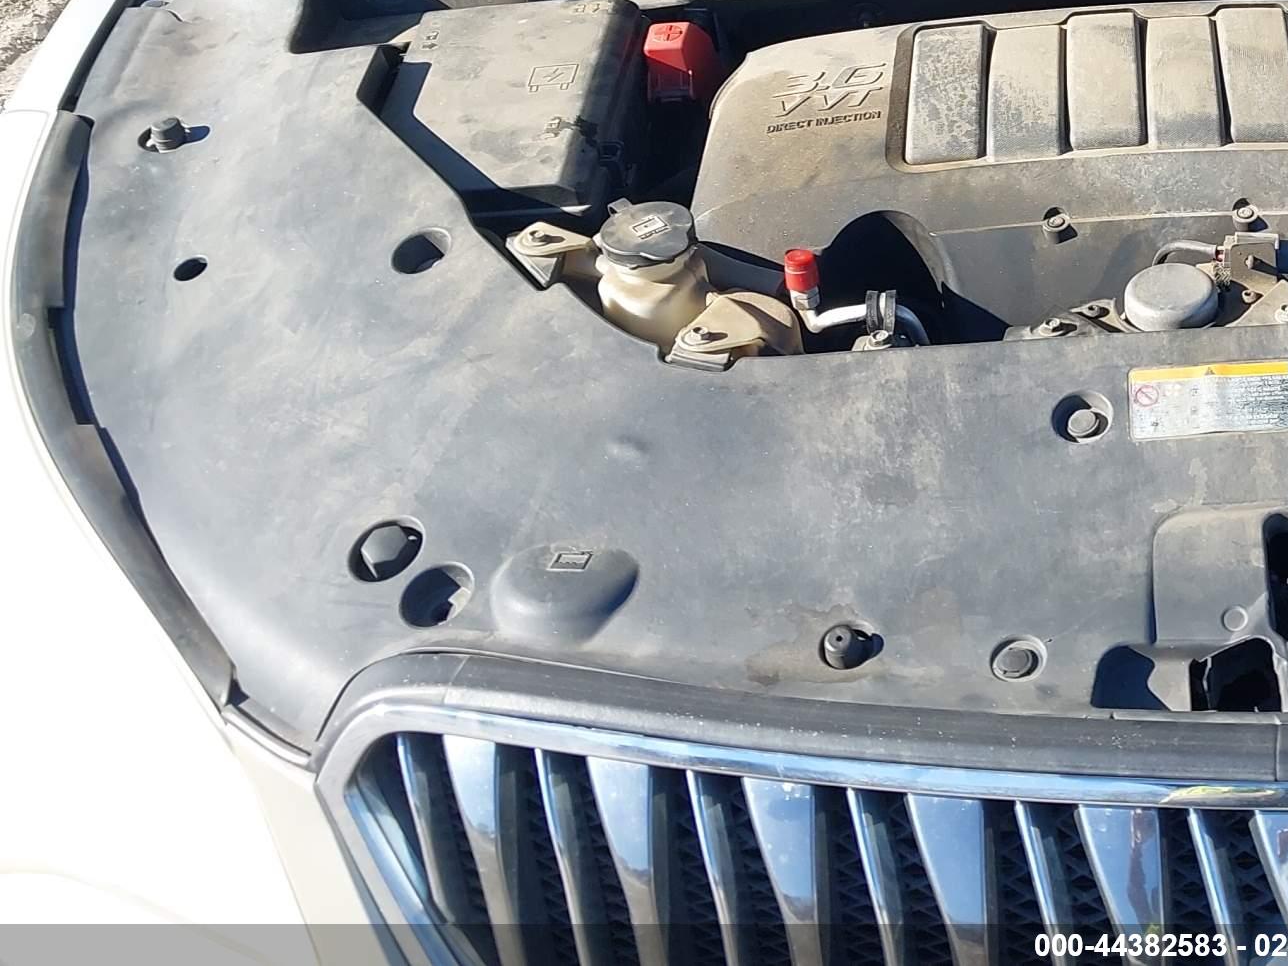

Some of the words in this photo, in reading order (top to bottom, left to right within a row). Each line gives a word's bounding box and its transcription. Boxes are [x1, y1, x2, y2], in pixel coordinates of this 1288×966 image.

[773, 63, 887, 98] 3.6
[774, 86, 884, 118] VVT
[766, 119, 814, 135] DIRECT
[815, 110, 882, 127] INJECTION
